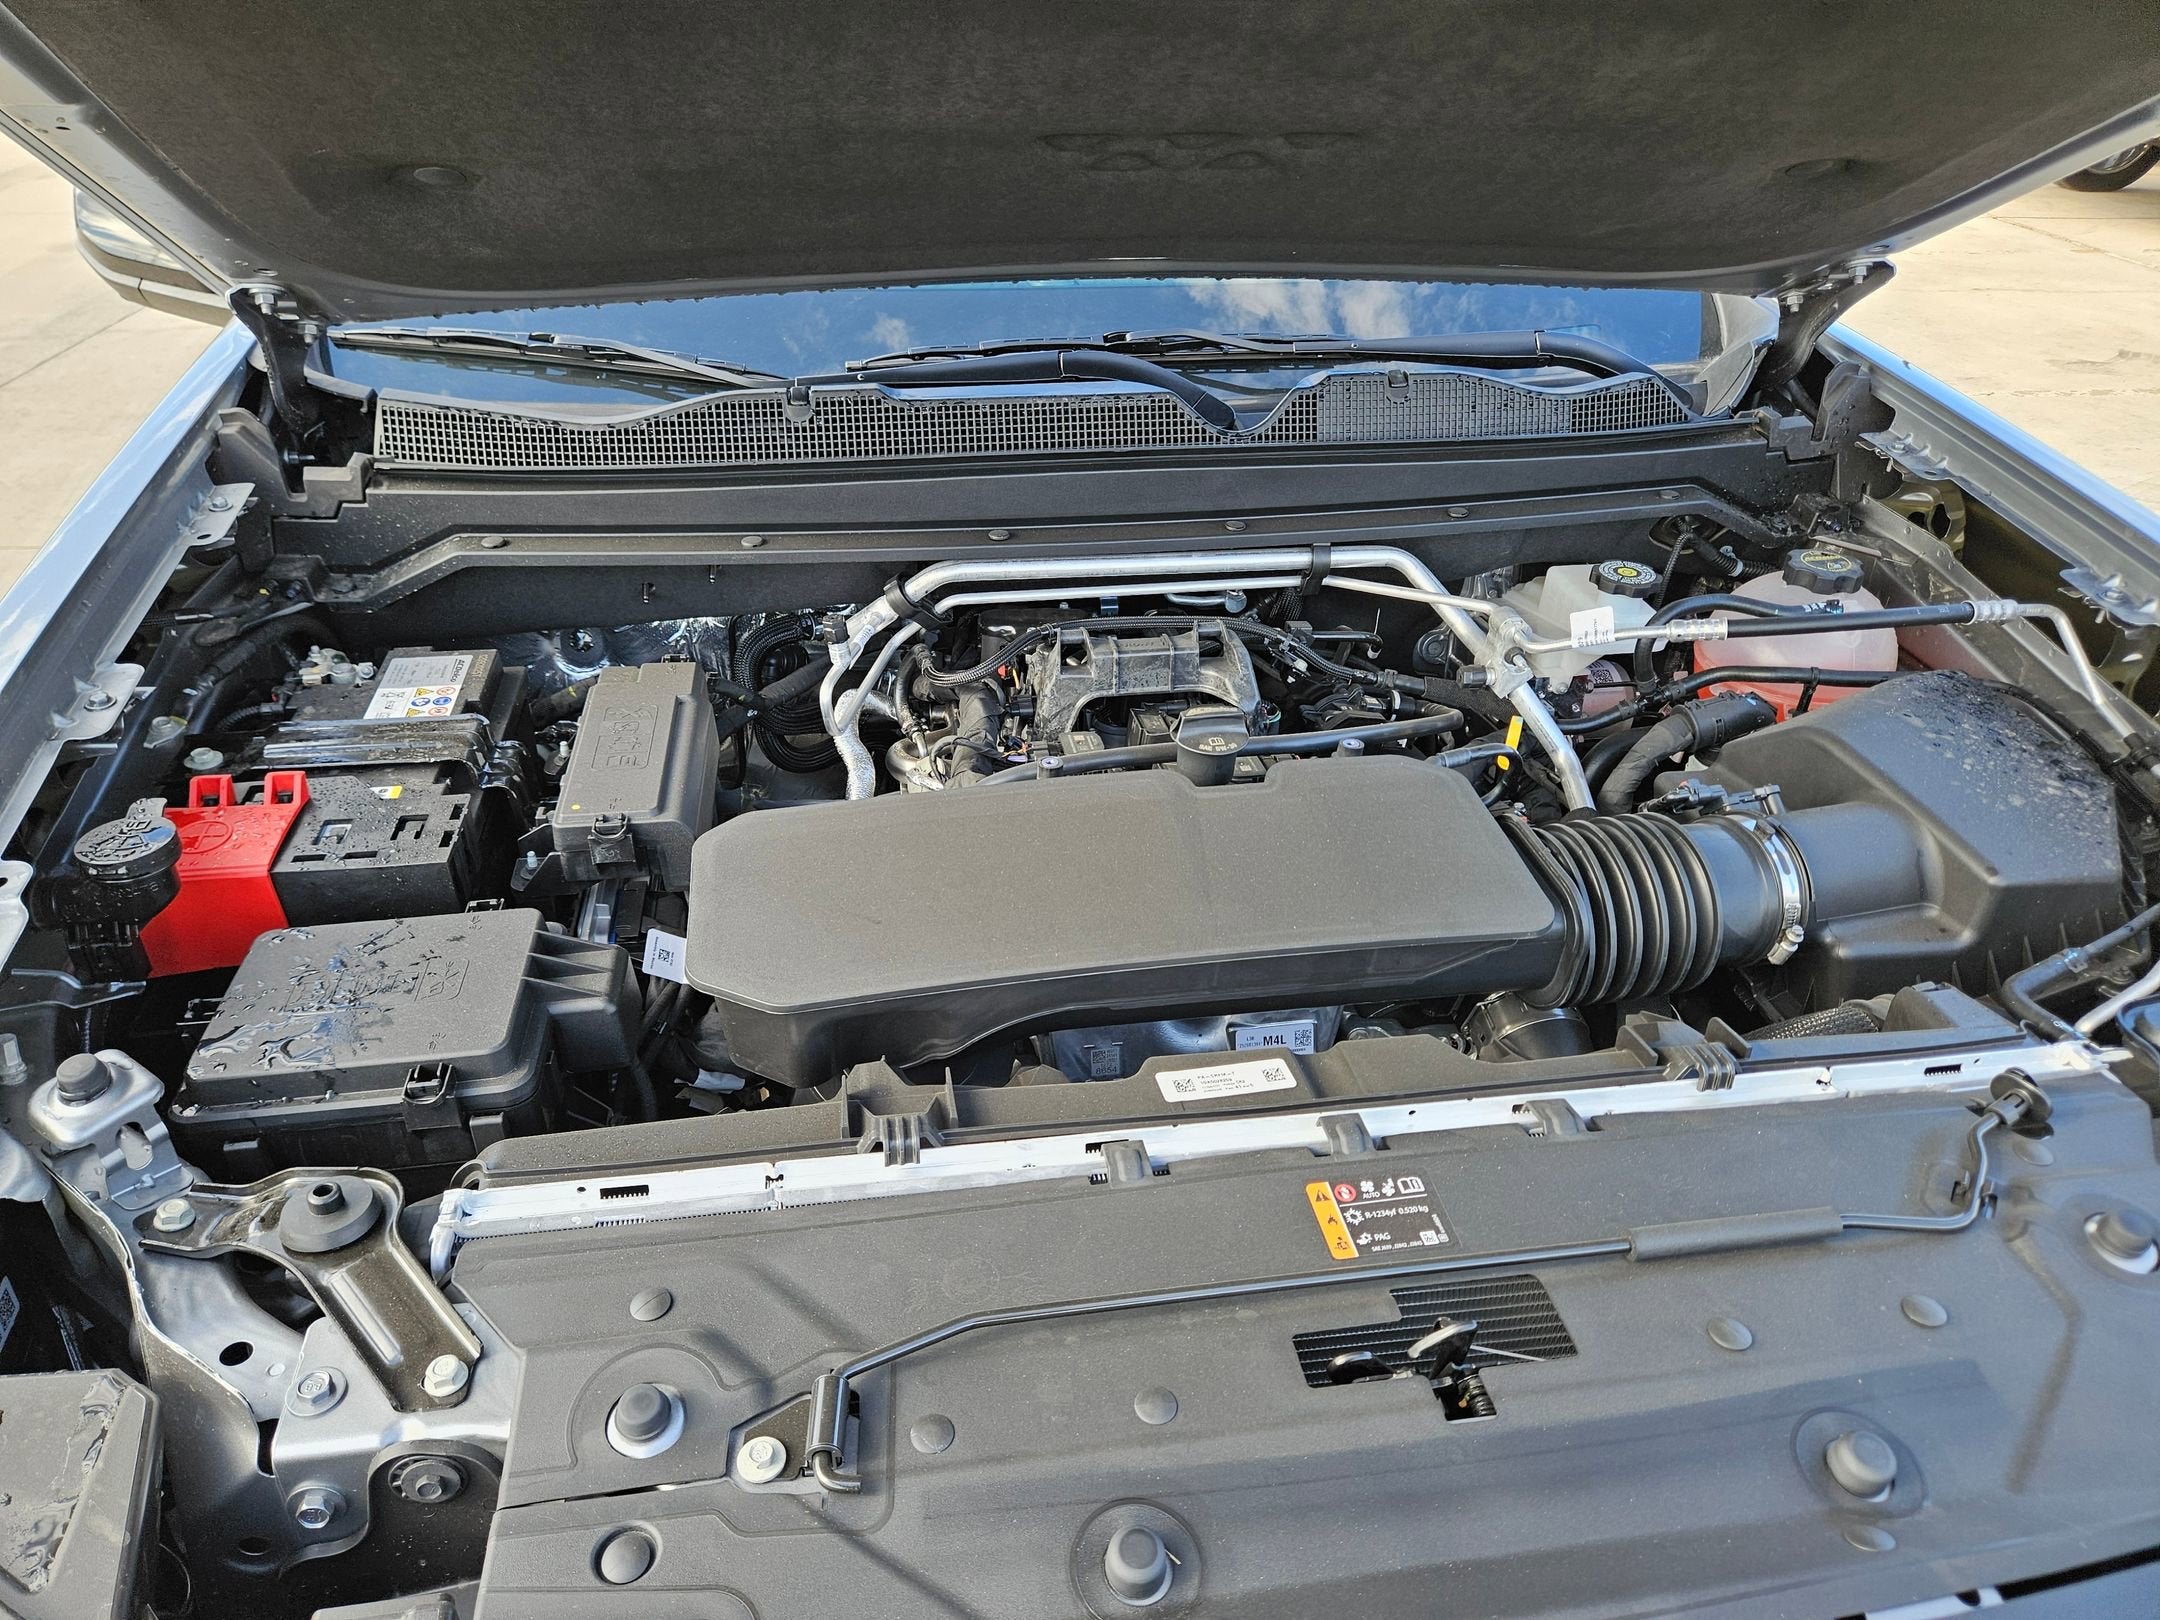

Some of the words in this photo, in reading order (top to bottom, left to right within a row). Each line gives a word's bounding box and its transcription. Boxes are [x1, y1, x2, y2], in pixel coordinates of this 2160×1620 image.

[450, 659, 465, 683] ACDelco
[1263, 1034, 1287, 1047] M4L
[1364, 1208, 1397, 1220] R-1234yf
[1398, 1206, 1418, 1215] 0.520
[1418, 1205, 1429, 1214] kg
[1373, 1232, 1391, 1241] PAG
